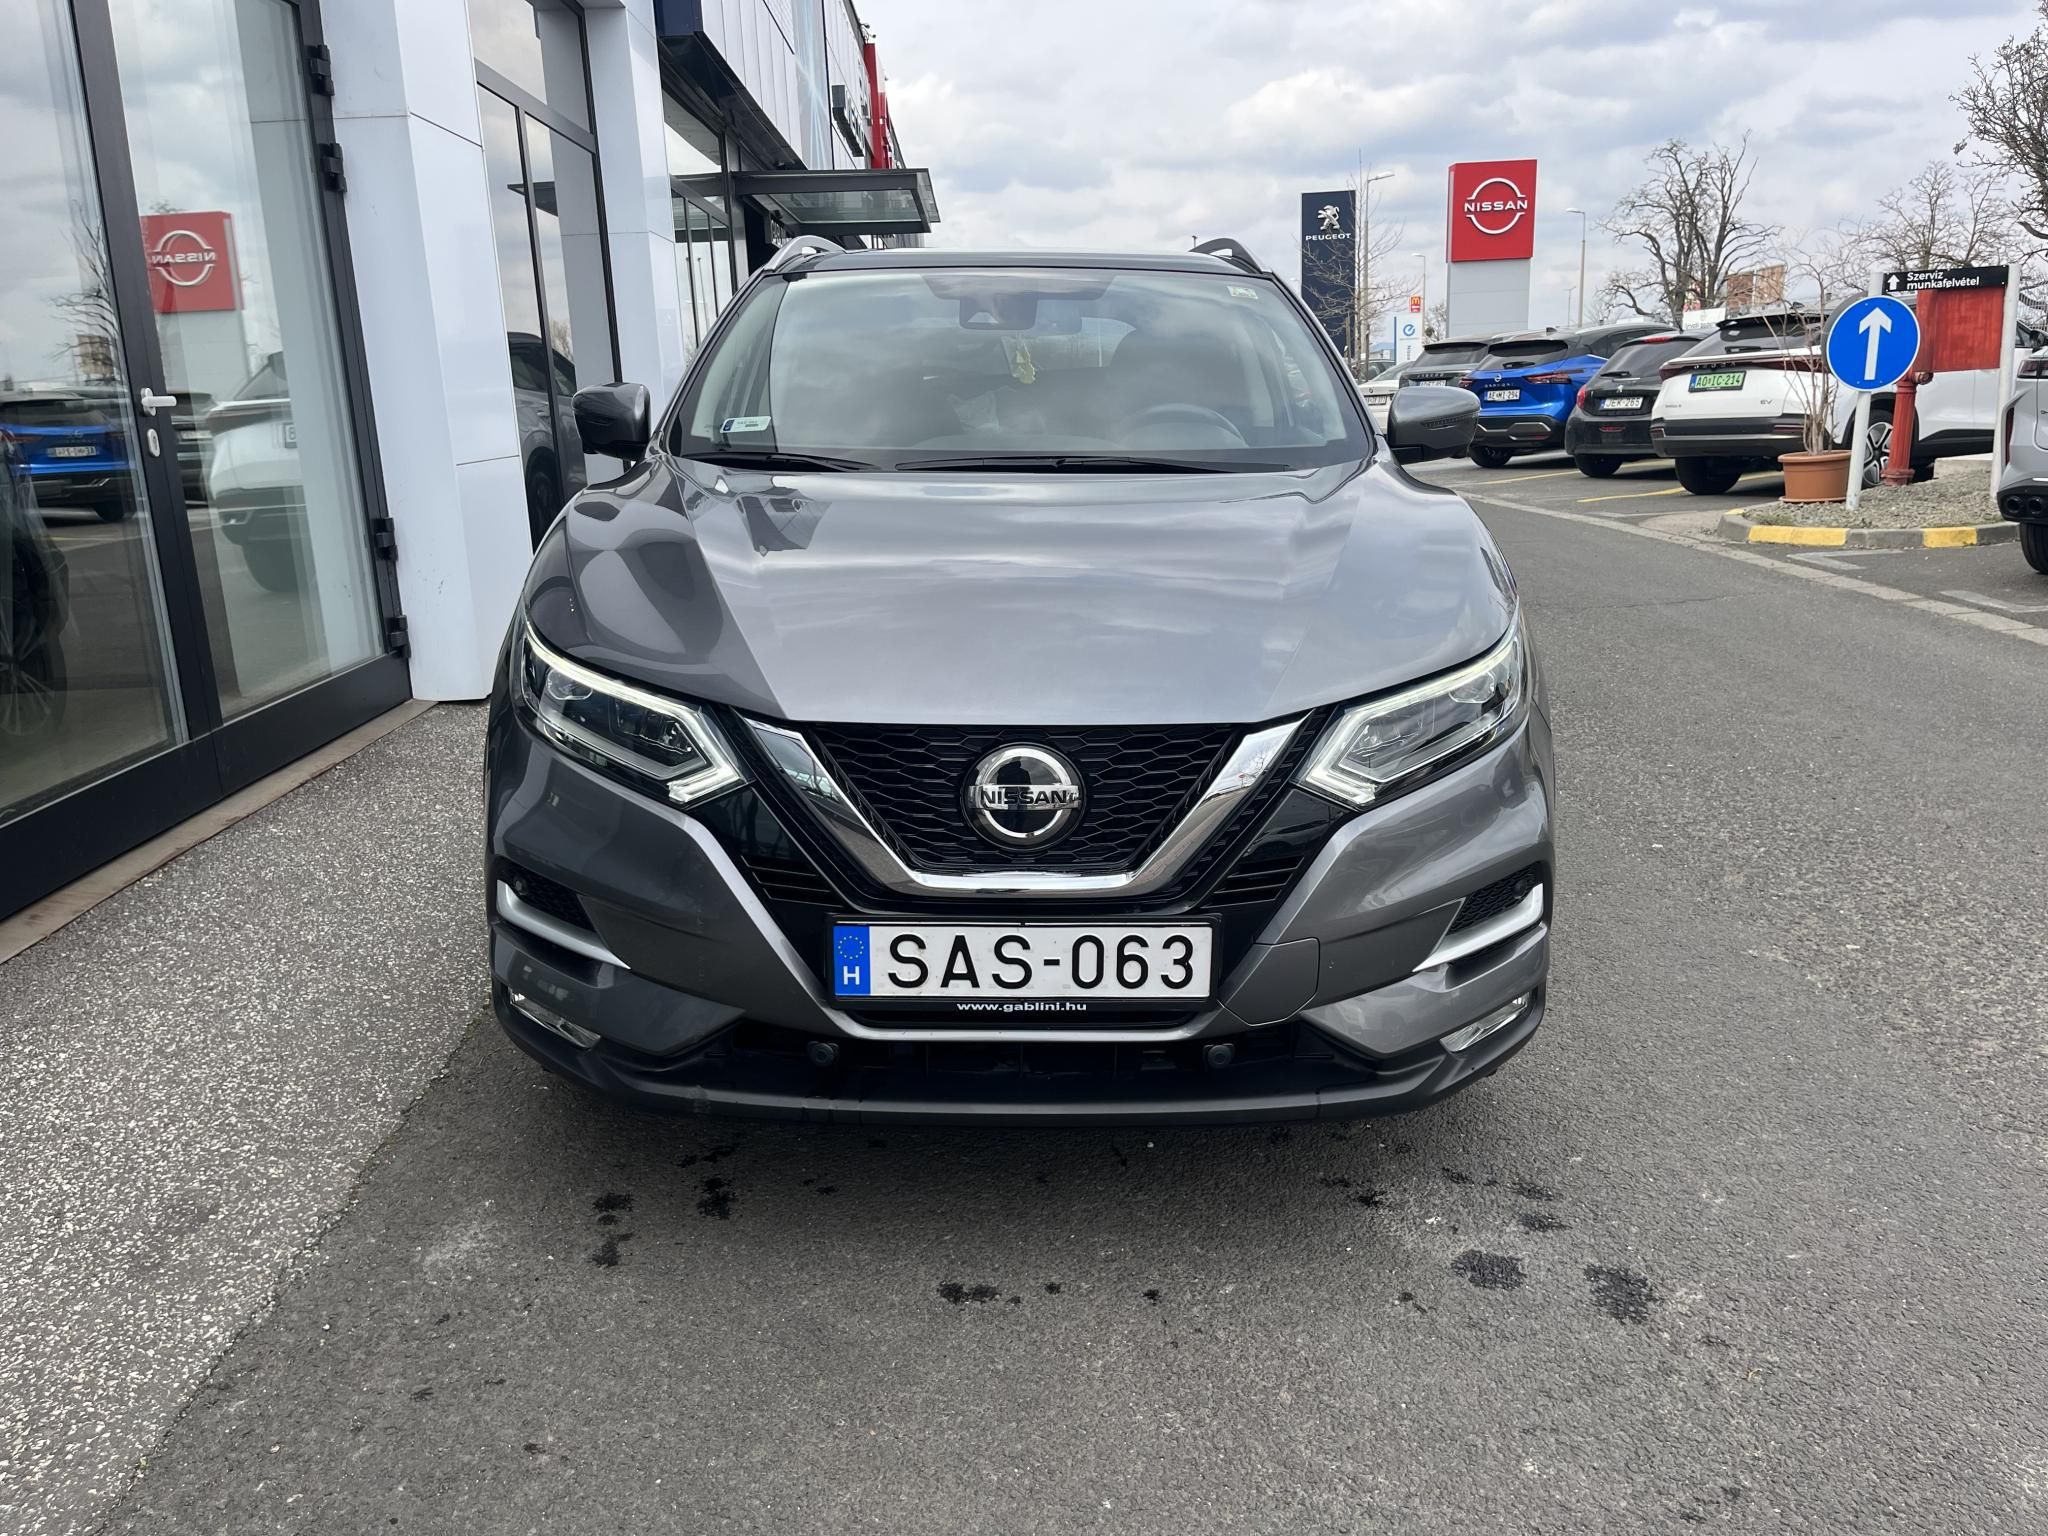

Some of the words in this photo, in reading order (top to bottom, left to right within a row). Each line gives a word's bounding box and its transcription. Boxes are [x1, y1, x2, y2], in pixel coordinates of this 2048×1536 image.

[1464, 199, 1528, 212] NISSAN
[1305, 233, 1352, 241] PEUGEOT
[1906, 270, 1944, 281] Szerviz
[1906, 276, 1980, 290] munkafelvétel
[981, 790, 1067, 805] NISSAN
[843, 966, 860, 985] H
[888, 933, 1194, 989] SAS-063
[957, 1002, 1087, 1013] www.gablini.hu
